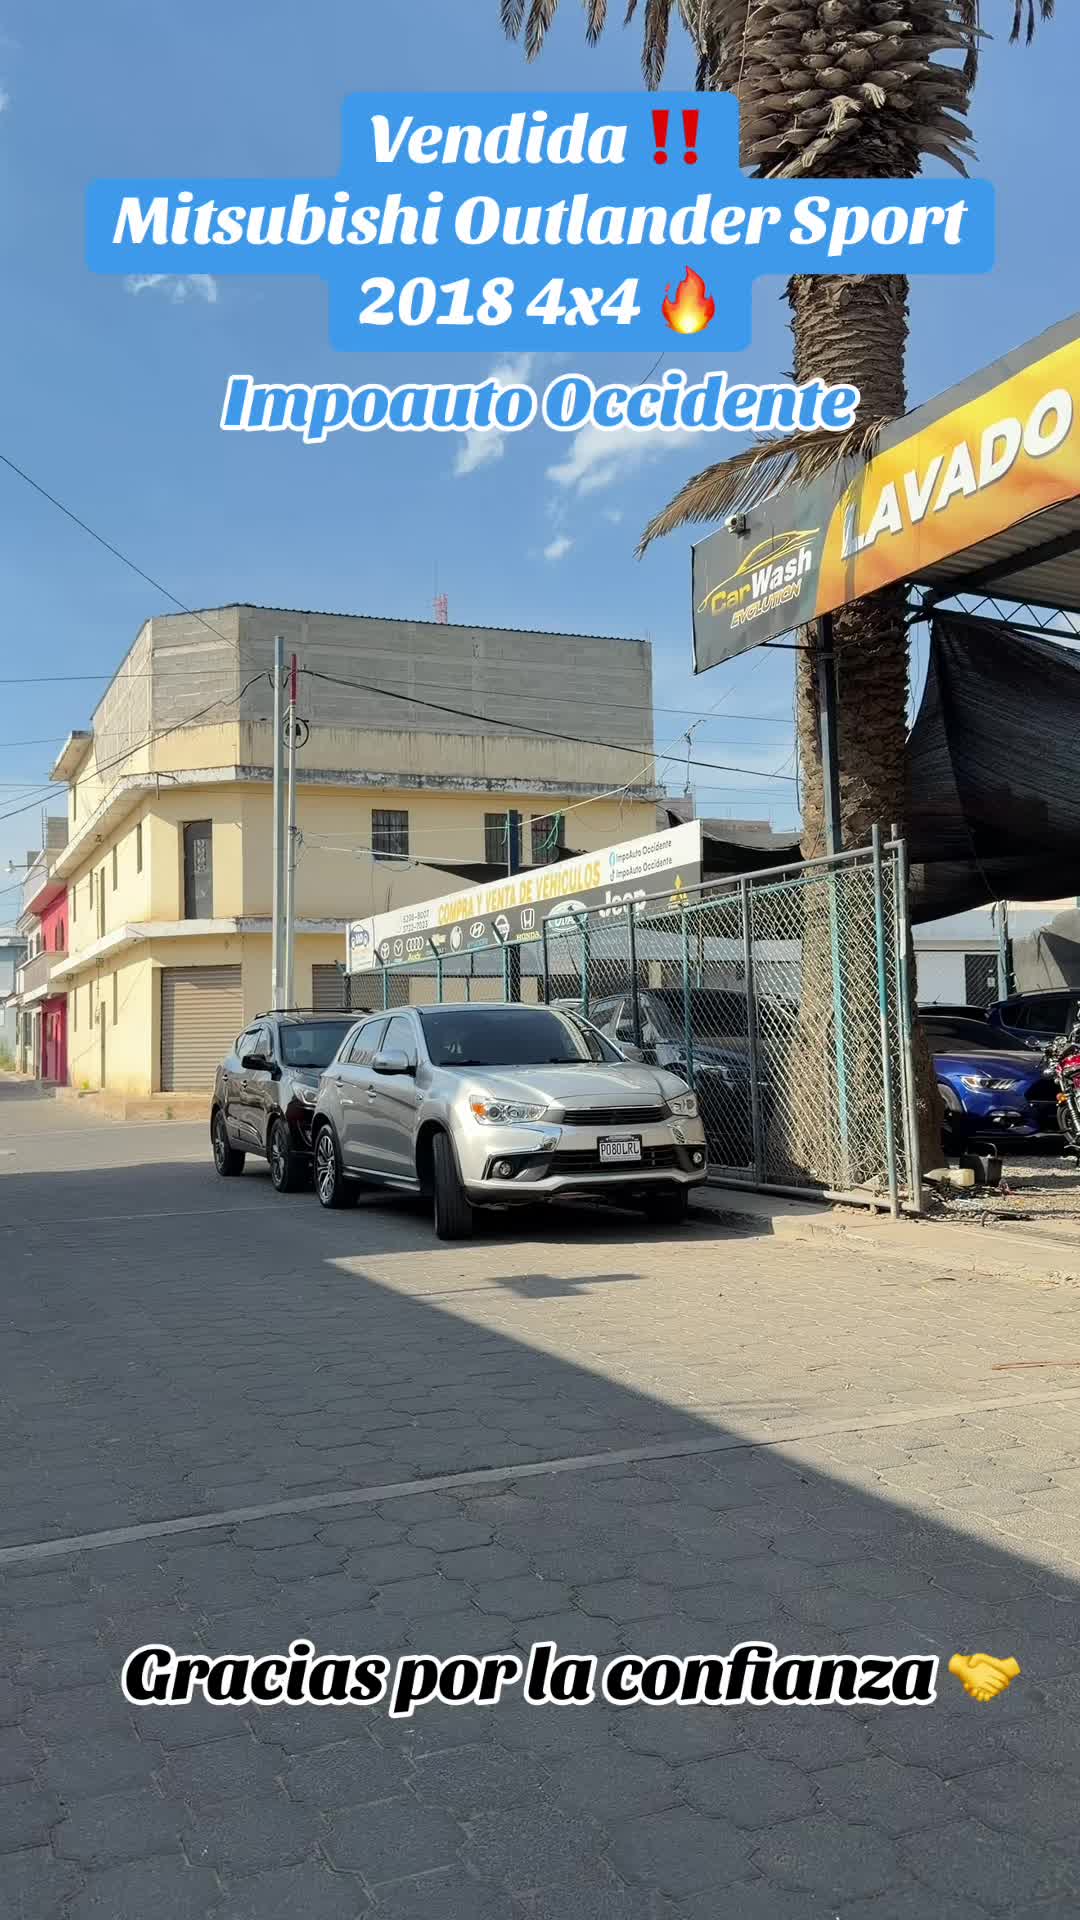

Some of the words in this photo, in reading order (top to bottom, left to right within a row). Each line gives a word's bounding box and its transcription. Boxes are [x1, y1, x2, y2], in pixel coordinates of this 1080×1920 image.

[840, 387, 1073, 560] LAVADO
[730, 578, 802, 629] EVOLUTION
[642, 840, 672, 855] Occidente
[643, 857, 672, 872] Occidente
[438, 897, 473, 926] COMPRA
[475, 892, 484, 912] Y
[485, 882, 516, 912] VENTA
[519, 877, 533, 901] DE
[516, 930, 541, 941] HONDA
